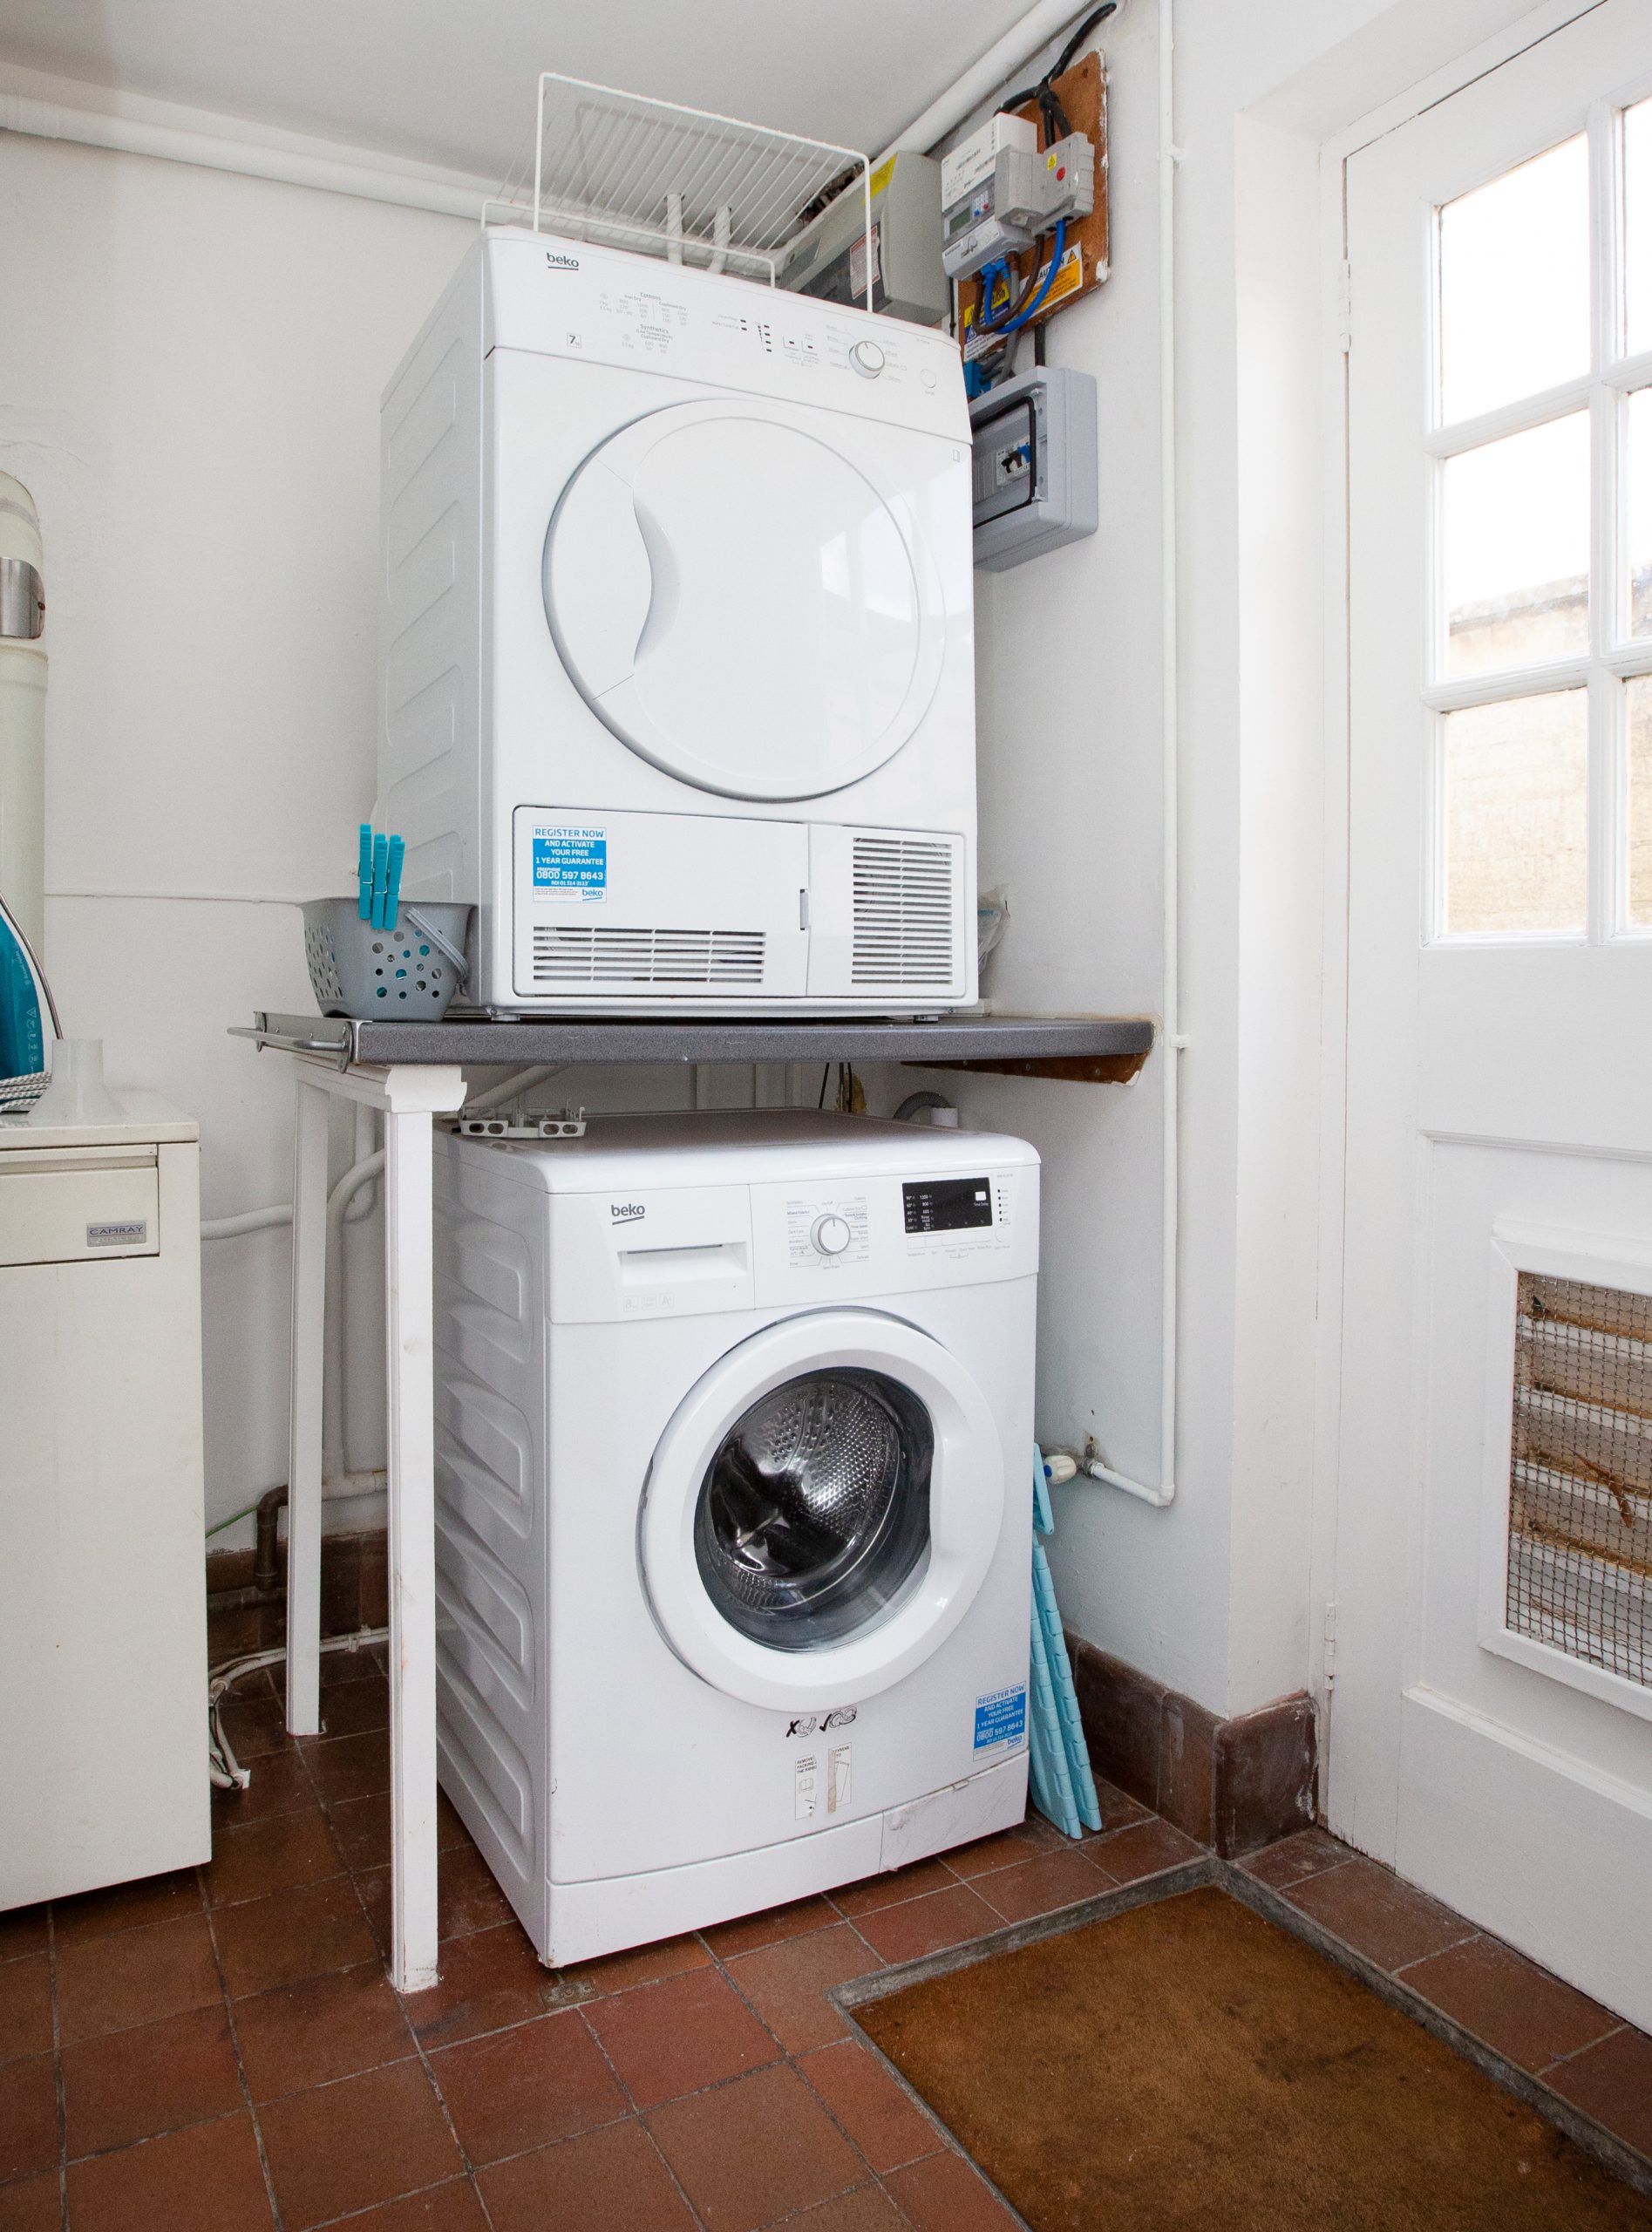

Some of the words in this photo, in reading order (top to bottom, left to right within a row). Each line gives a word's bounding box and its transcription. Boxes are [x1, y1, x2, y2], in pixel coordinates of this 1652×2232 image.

[547, 252, 580, 268] beko
[640, 324, 669, 334] Synthetics
[569, 335, 576, 344] 7
[535, 828, 580, 837] REGISTER
[611, 1203, 645, 1216] beko
[89, 1226, 144, 1235] CAMRAY
[977, 1691, 1009, 1705] REGISTER
[1010, 1684, 1024, 1694] NOW
[984, 1704, 995, 1712] AND
[996, 1696, 1018, 1708] ACTIVATE
[1003, 1705, 1015, 1714] FREE
[996, 1709, 1023, 1723] GUARANTEE
[977, 1730, 994, 1742] 0800
[995, 1726, 1006, 1736] 597
[1007, 1736, 1023, 1745] beko
